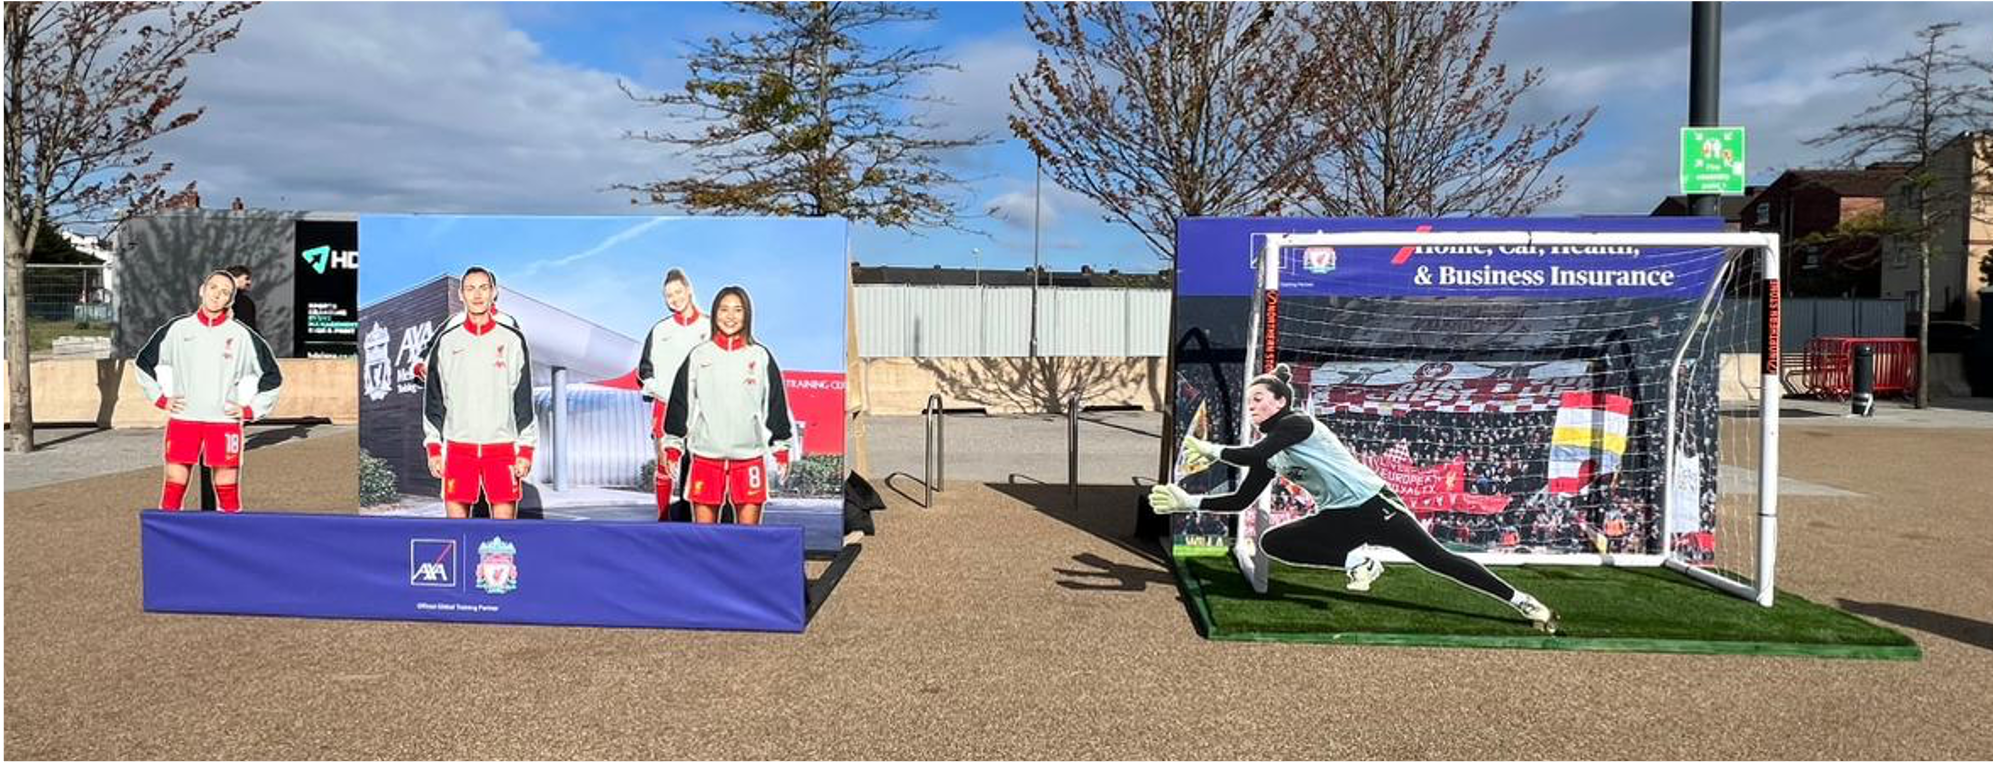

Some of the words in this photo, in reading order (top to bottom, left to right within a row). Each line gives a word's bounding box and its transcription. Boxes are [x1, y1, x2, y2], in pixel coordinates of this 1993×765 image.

[1414, 265, 1433, 285] &
[1439, 265, 1545, 286] Business
[1551, 266, 1675, 286] Insurance
[1769, 279, 1778, 309] STONE
[1266, 305, 1278, 352] NORTHERN
[1768, 311, 1778, 359] NORTHERN
[1264, 353, 1275, 374] STO
[224, 433, 239, 454] 18
[748, 465, 762, 488] 8
[411, 563, 447, 581] AXA
